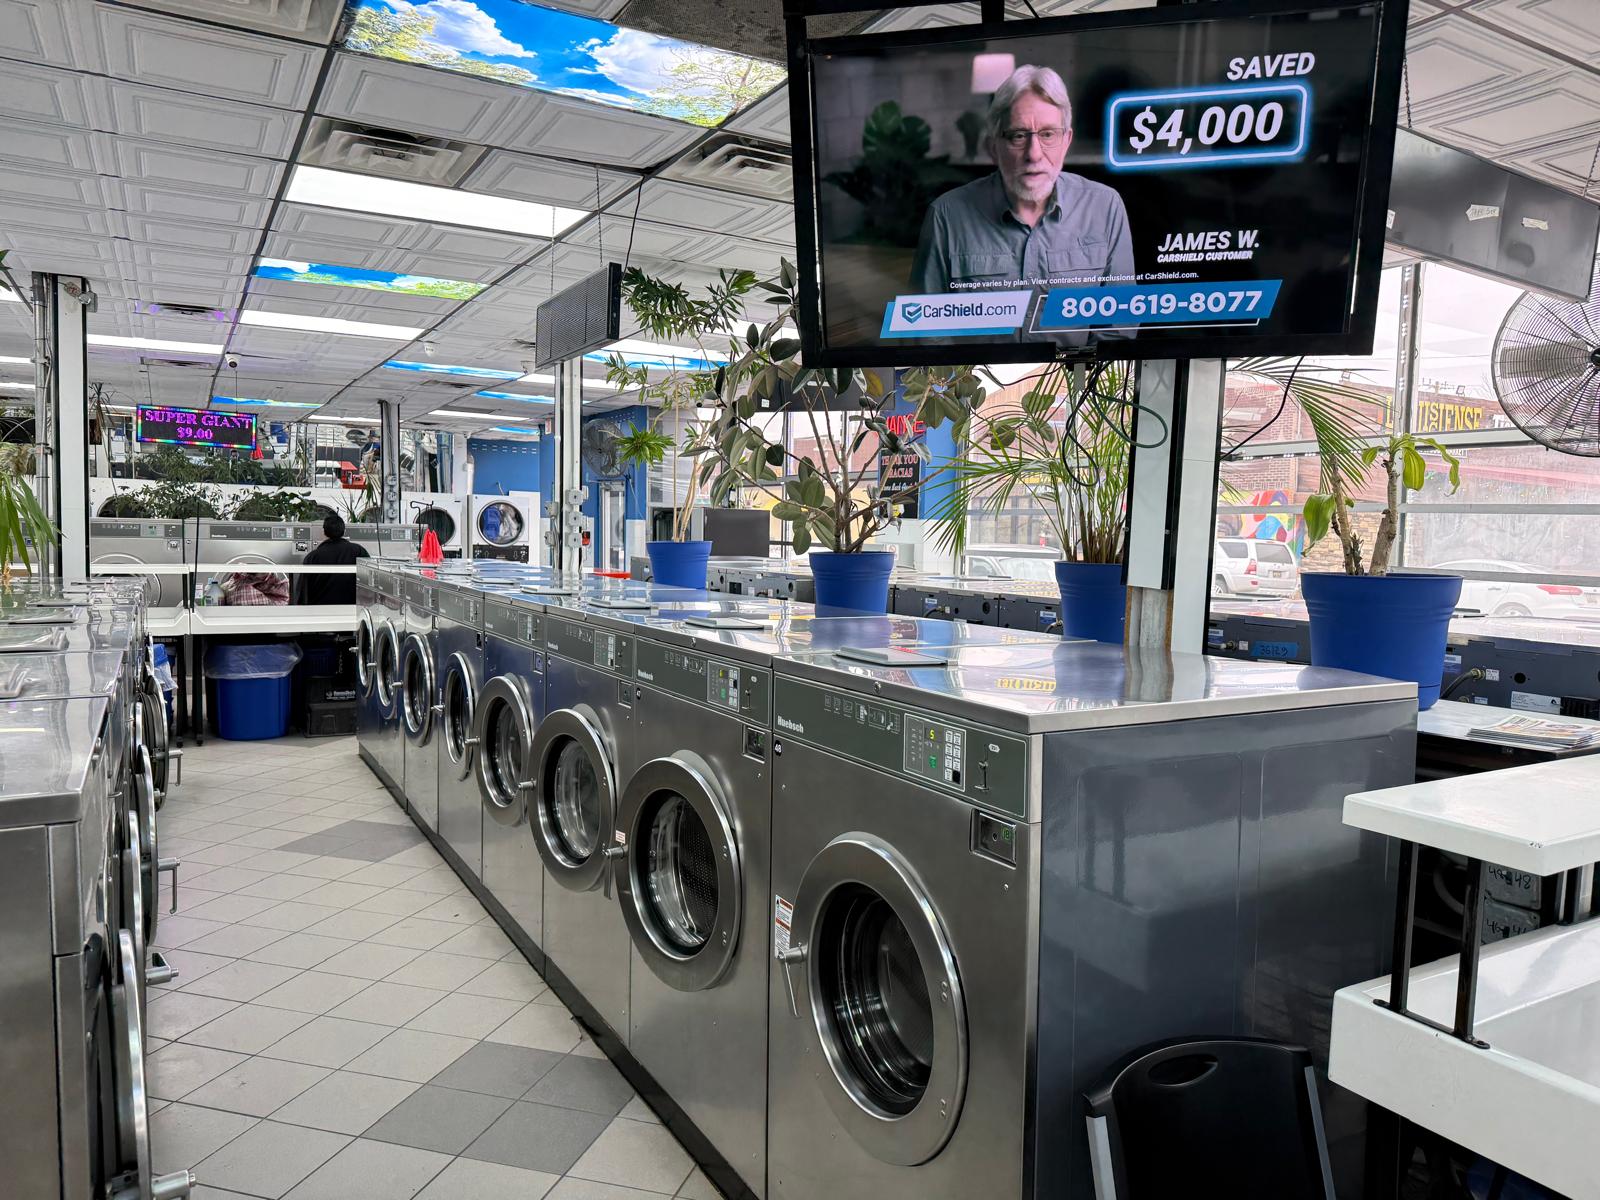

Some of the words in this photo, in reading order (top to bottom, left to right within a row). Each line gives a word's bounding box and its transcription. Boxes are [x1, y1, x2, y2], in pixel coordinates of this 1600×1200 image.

[1226, 52, 1316, 81] SAVED
[1129, 101, 1284, 155] $4,000
[1157, 230, 1232, 252] JAMES
[1238, 229, 1260, 249] W.
[1157, 252, 1205, 263] CARSHIELD
[1205, 250, 1254, 261] CUSTOMER
[949, 280, 981, 290] Coverage
[982, 280, 1002, 288] varies
[1003, 278, 1012, 288] by
[1013, 278, 1030, 287] plan.
[1031, 277, 1048, 285] View
[1049, 276, 1082, 285] contracts
[1083, 275, 1097, 283] and
[1097, 273, 1135, 282] exclusions
[1136, 273, 1144, 281] at
[1145, 271, 1200, 280] CarShield.com.
[923, 302, 1018, 319] CarShield.com
[1061, 290, 1264, 318] 800-619-8077
[145, 410, 197, 424] SUPER
[201, 414, 252, 429] GIANT
[177, 427, 213, 439] $9.00
[887, 468, 913, 478] RACIAS
[777, 715, 804, 734] Huebsch
[1515, 872, 1532, 889] 48
